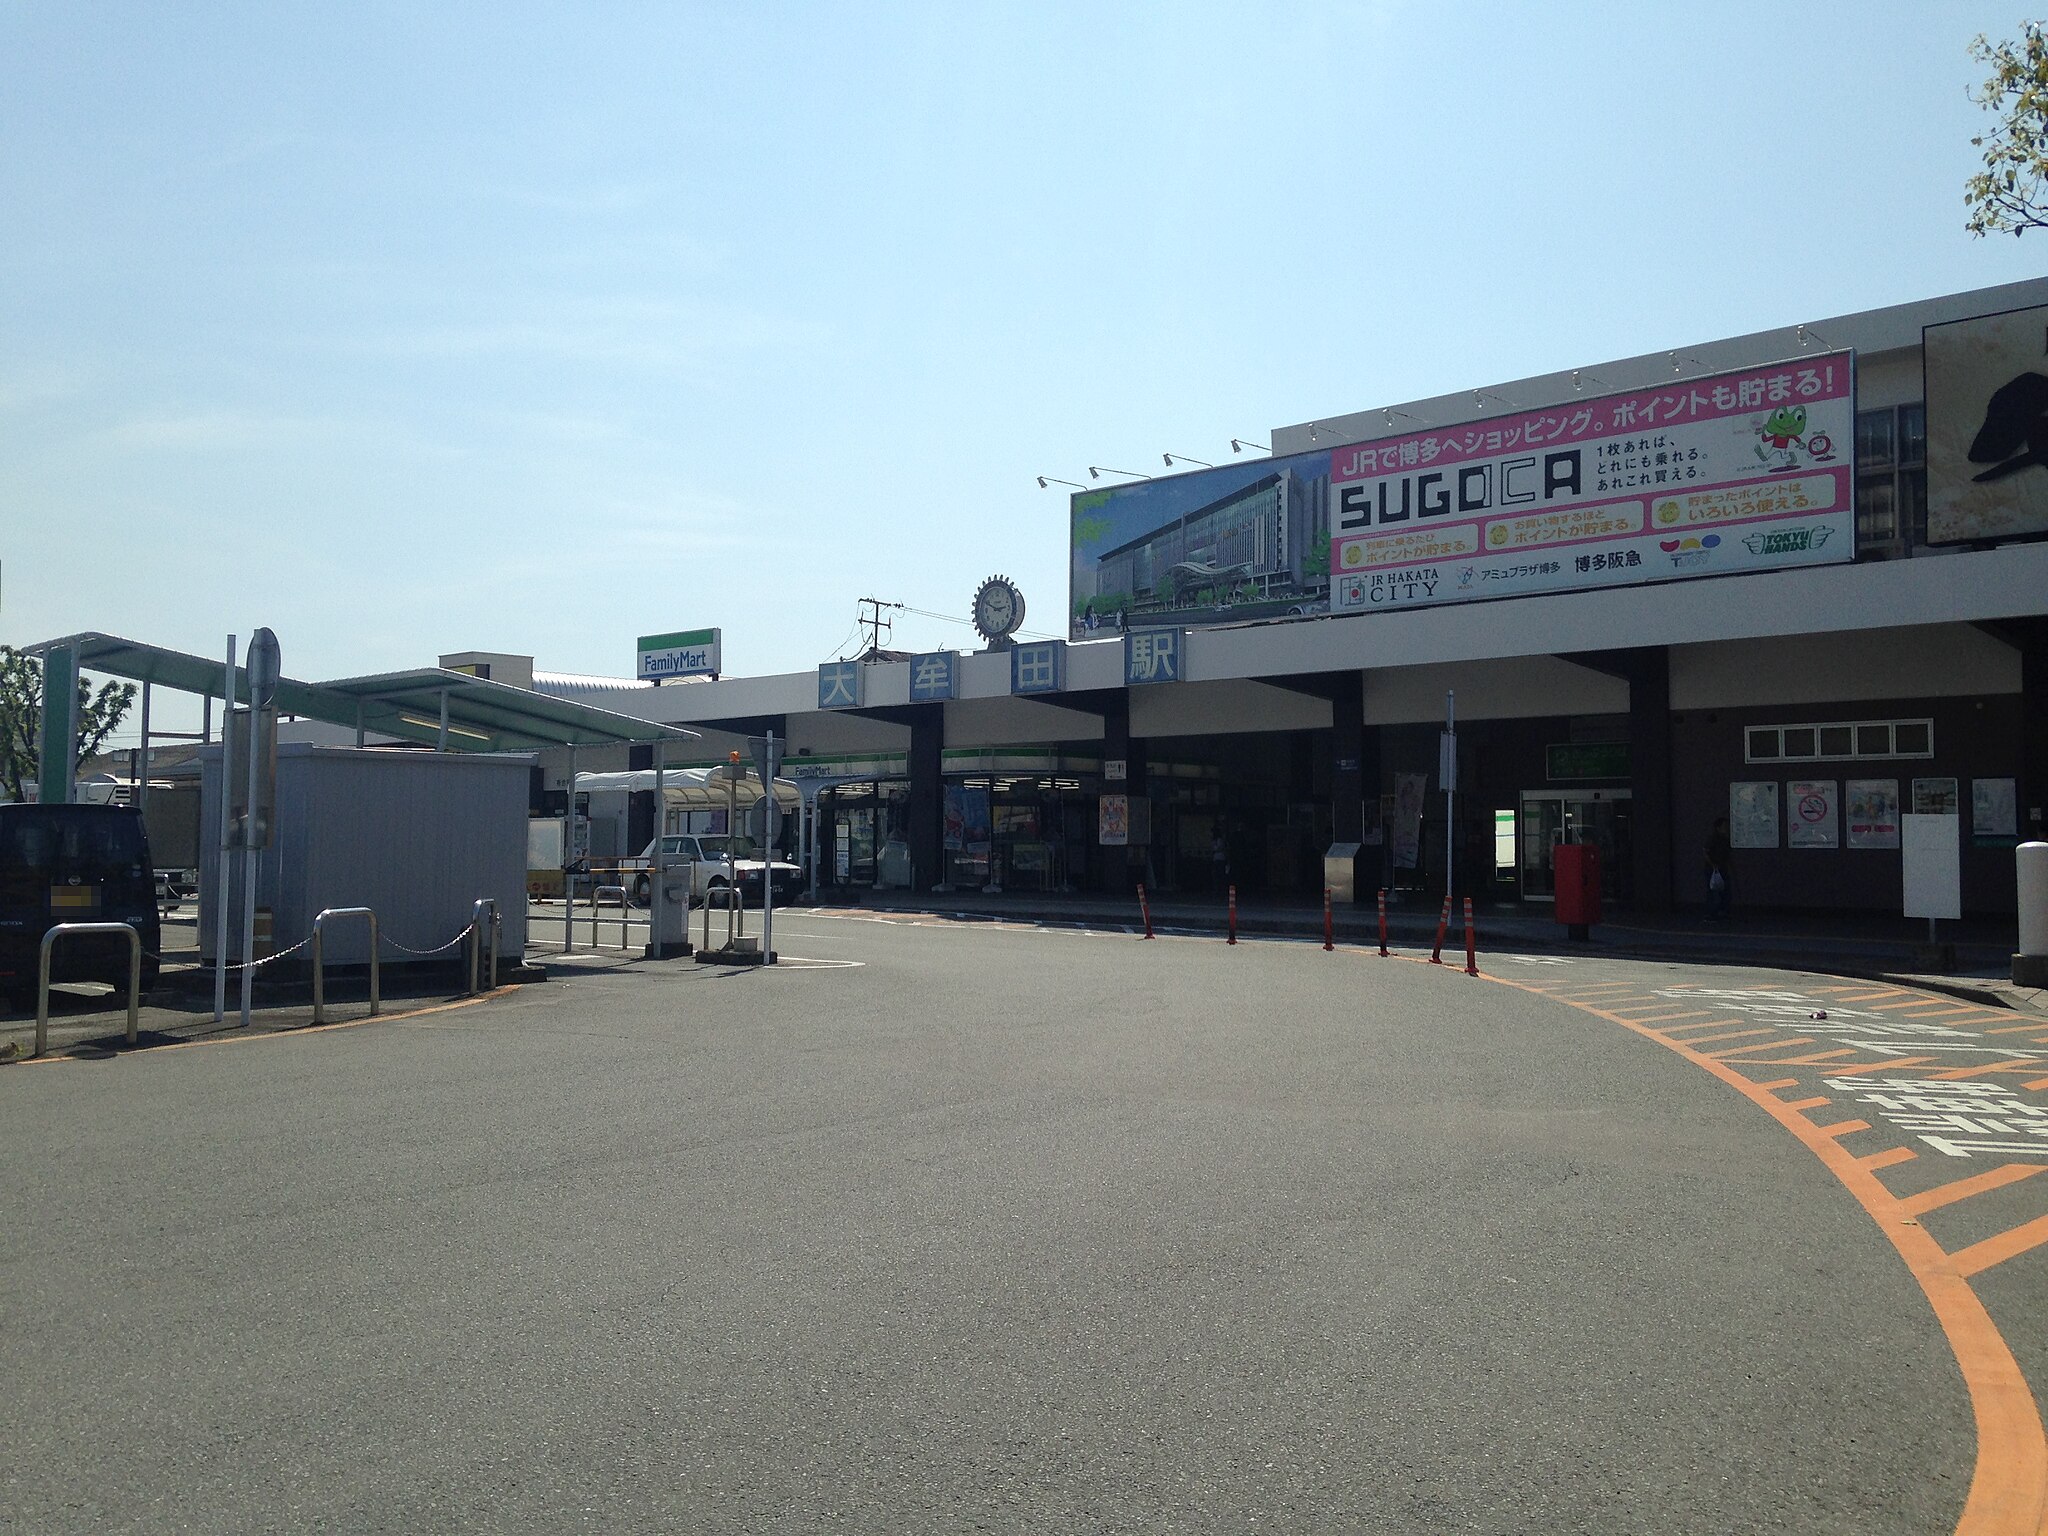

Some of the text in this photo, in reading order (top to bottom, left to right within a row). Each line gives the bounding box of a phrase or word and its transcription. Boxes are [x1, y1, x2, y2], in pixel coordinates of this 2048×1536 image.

[1597, 435, 1675, 457] 1枚あれば、
[1597, 448, 1708, 474] どれにも乗れる。
[1341, 449, 1581, 529] SUGOCA
[1597, 466, 1706, 491] あれこれ買える。
[1688, 483, 1801, 507] 貯まったポイントは
[1688, 494, 1818, 521] いろいろ使える。
[1514, 518, 1636, 543] ポイントが貯まる。
[1766, 530, 1809, 544] TOKYU
[1366, 541, 1473, 562] ポイントが貯まる。
[1764, 540, 1808, 554] HANDS
[1481, 562, 1561, 581] アミュプラザ博多
[1575, 550, 1641, 573] 博多阪急
[1371, 568, 1439, 587] JR HAKATA
[1370, 580, 1439, 602] CITY
[644, 650, 706, 672] FamilyMart
[823, 632, 1174, 705] 大牟田駅
[795, 766, 831, 776] FamilyMart
